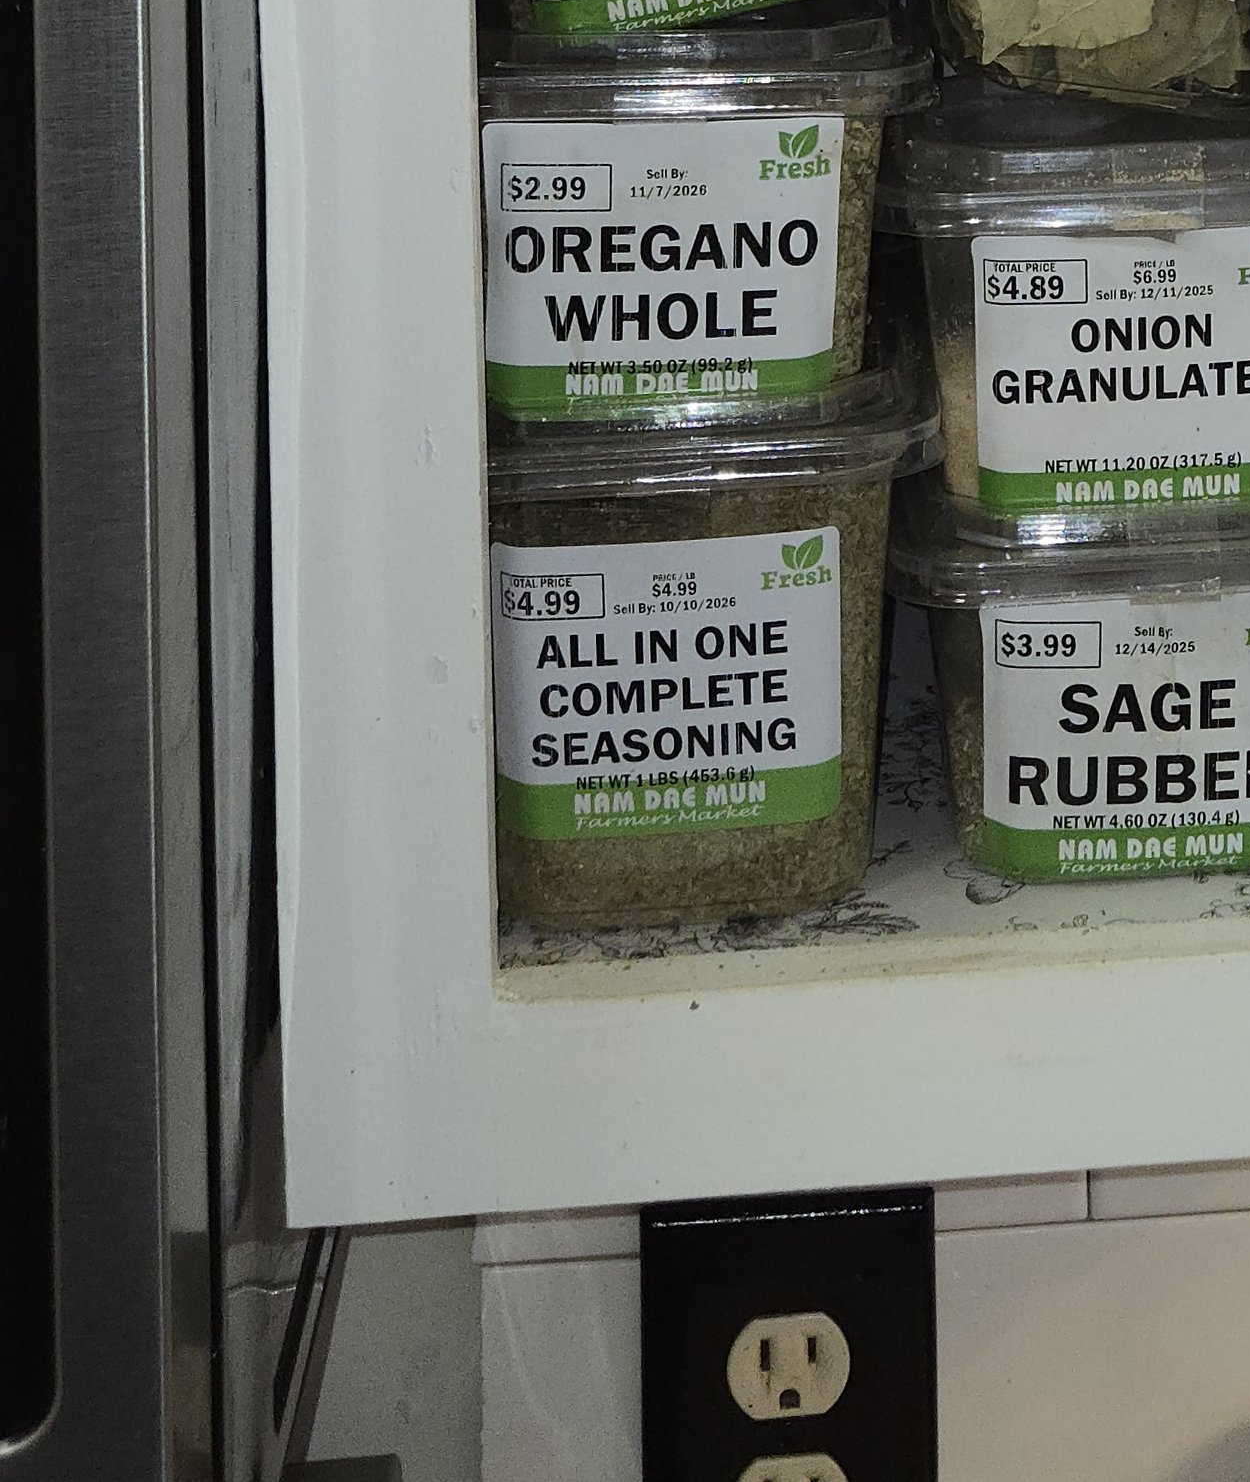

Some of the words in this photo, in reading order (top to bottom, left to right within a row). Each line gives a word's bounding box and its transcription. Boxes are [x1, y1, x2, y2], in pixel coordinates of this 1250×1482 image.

[759, 155, 830, 181] Fresh
[508, 175, 586, 201] $2.99
[630, 184, 707, 199] 11/7/2026
[505, 219, 818, 274] OREGANO
[987, 275, 1065, 301] $4.89
[1133, 268, 1177, 285] $6.99
[545, 289, 777, 342] WHOLE
[1071, 313, 1213, 353] ONION
[652, 581, 697, 597] $4.99
[761, 565, 832, 590] Fresh
[504, 590, 580, 616] $4.99
[536, 634, 618, 669] ALL
[634, 631, 677, 665] IN
[695, 620, 788, 660] ONE
[1001, 633, 1077, 658] $3.99
[1115, 641, 1196, 656] 12/14/2025
[539, 669, 788, 718] COMPLETE
[1059, 679, 1236, 734] SAGE
[532, 717, 797, 767] SEASONING
